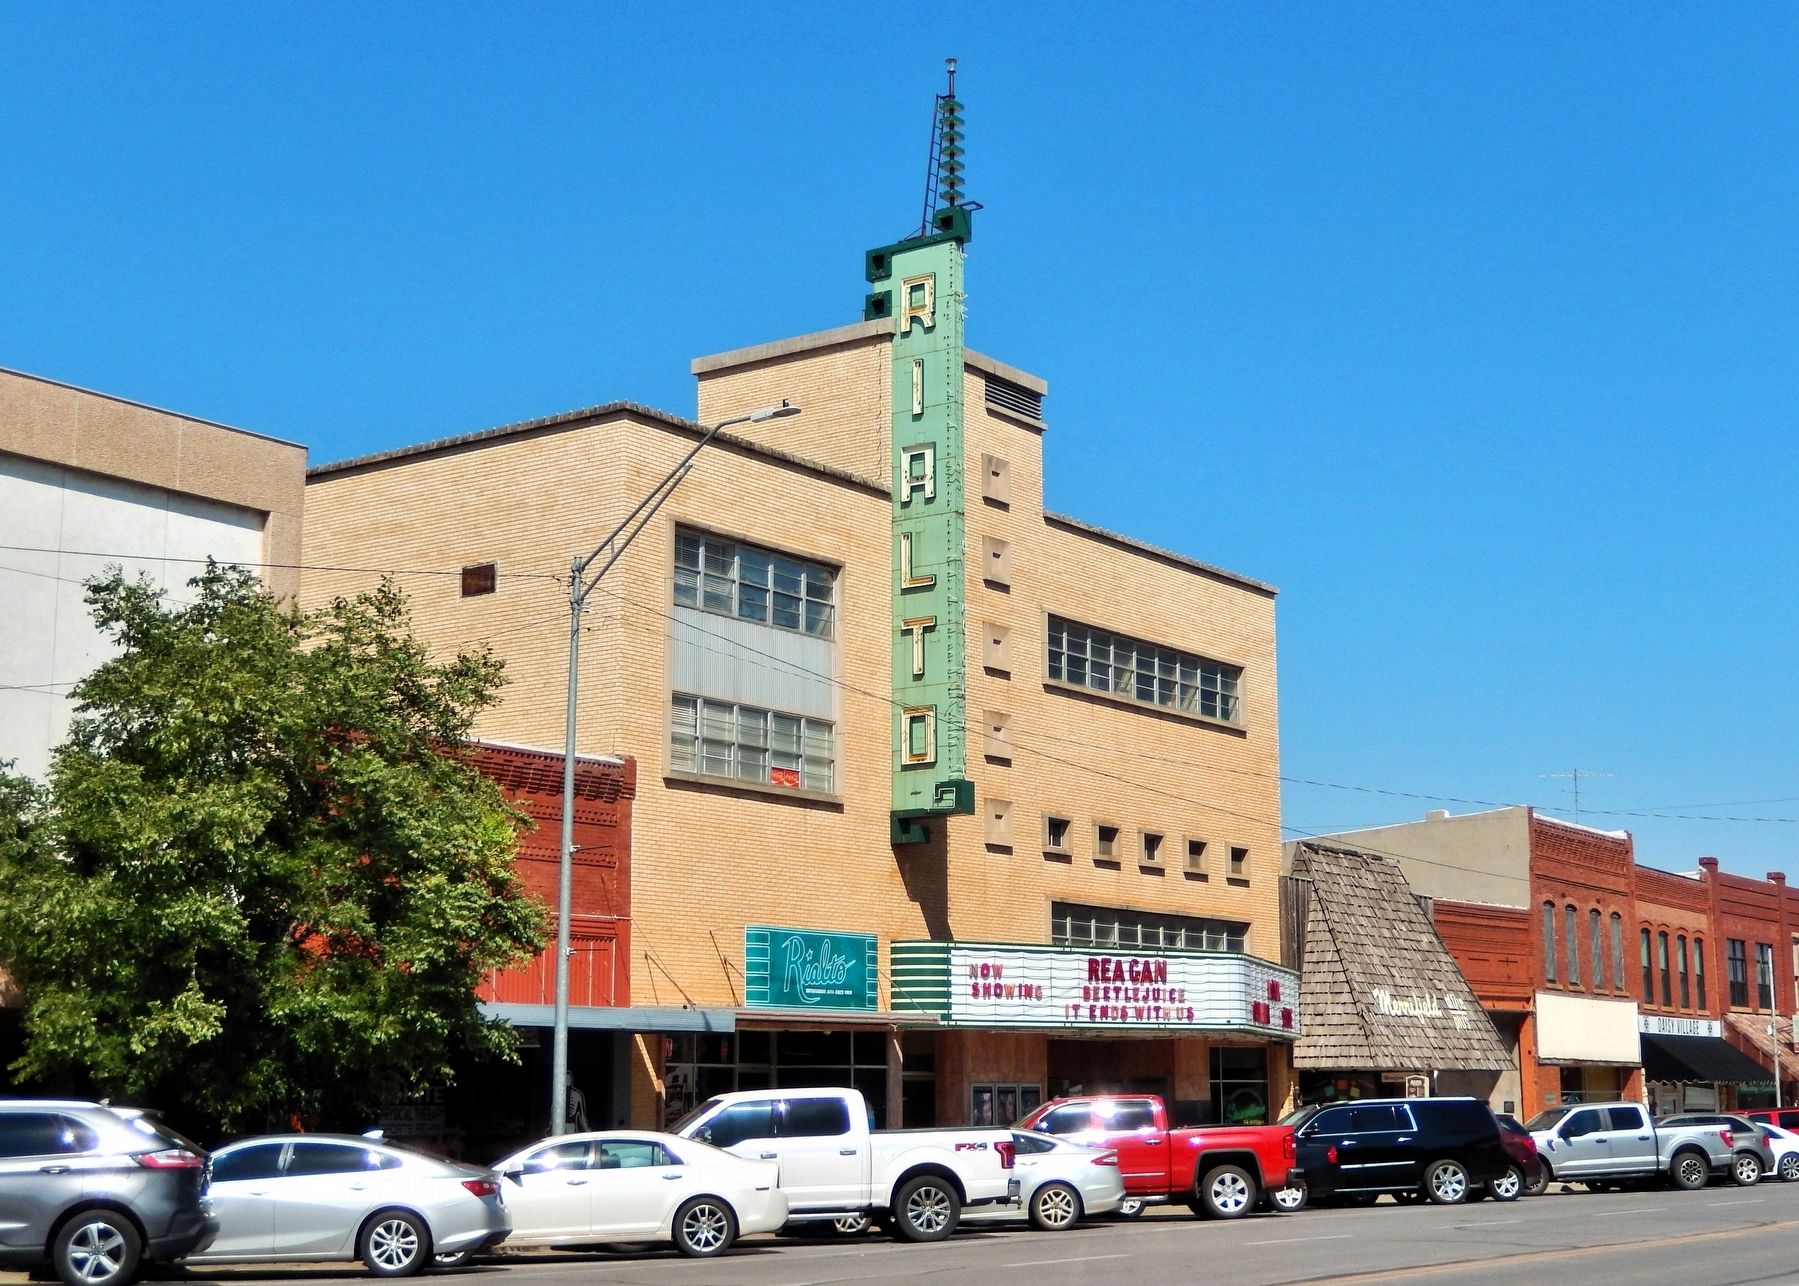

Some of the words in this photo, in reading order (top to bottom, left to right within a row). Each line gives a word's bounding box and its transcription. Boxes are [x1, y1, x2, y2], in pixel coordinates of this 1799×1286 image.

[901, 271, 937, 768] RIALTO
[782, 935, 856, 1003] Rialto
[969, 963, 1004, 981] NOW
[1088, 957, 1168, 986] REAGAN
[971, 982, 1043, 1002] SHOWING
[1083, 985, 1185, 1005] BEETLEJUICE
[1064, 1003, 1081, 1021] IT
[1089, 1004, 1129, 1023] ENDS
[1134, 1005, 1171, 1022] WITH
[1176, 1006, 1195, 1023] US
[1372, 987, 1442, 1025] Merrifield
[1658, 1017, 1675, 1034] DAISY
[1676, 1019, 1700, 1036] VILLAGE
[954, 1142, 988, 1152] FX4
